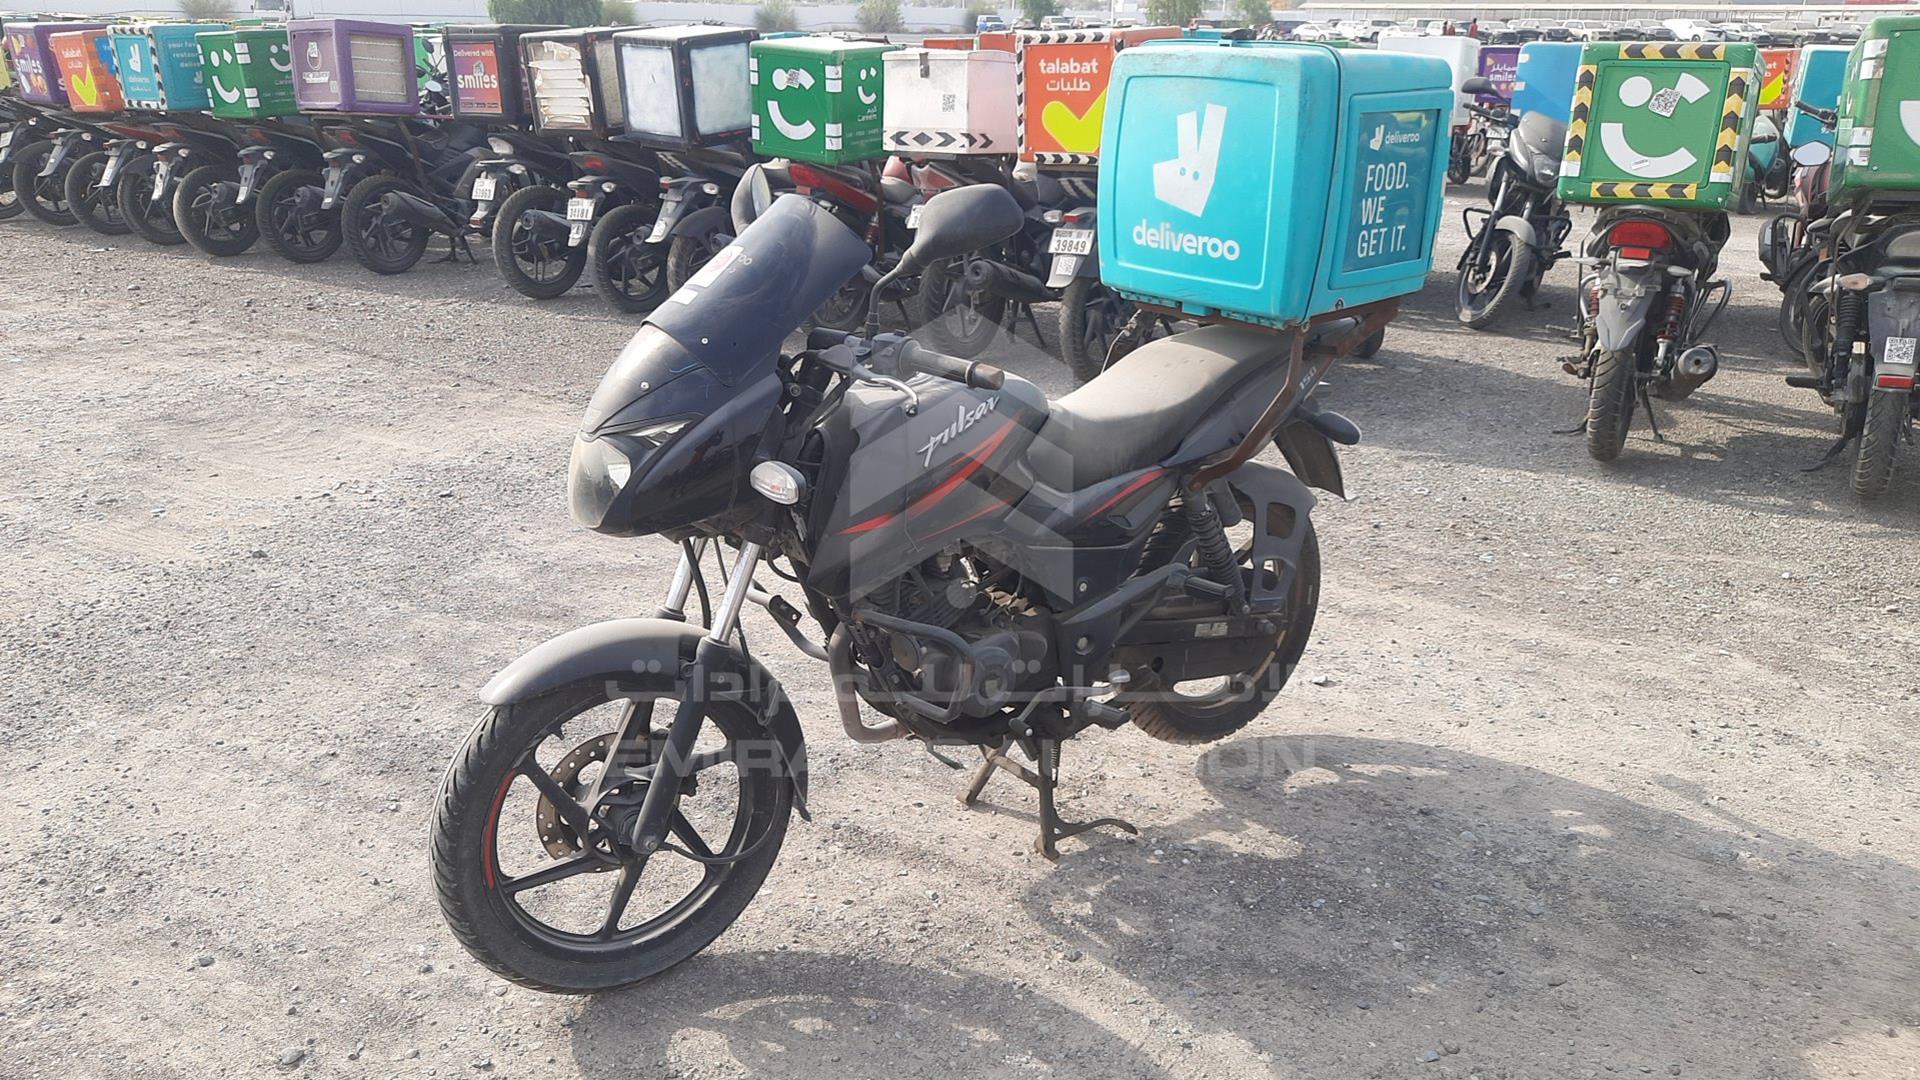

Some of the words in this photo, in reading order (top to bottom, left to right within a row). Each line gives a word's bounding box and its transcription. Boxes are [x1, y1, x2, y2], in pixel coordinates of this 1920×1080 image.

[453, 48, 480, 57] Delivered
[481, 48, 495, 57] with
[1039, 57, 1099, 74] talabat
[457, 73, 498, 89] smiles
[1046, 77, 1091, 96] طلبات
[1385, 131, 1420, 144] deliveroo
[1364, 161, 1409, 193] FOOD.
[1361, 195, 1386, 226] WE
[1054, 239, 1088, 253] 39849
[1132, 218, 1241, 261] deliveroo
[1357, 227, 1388, 258] GET
[1389, 224, 1407, 253] IT.
